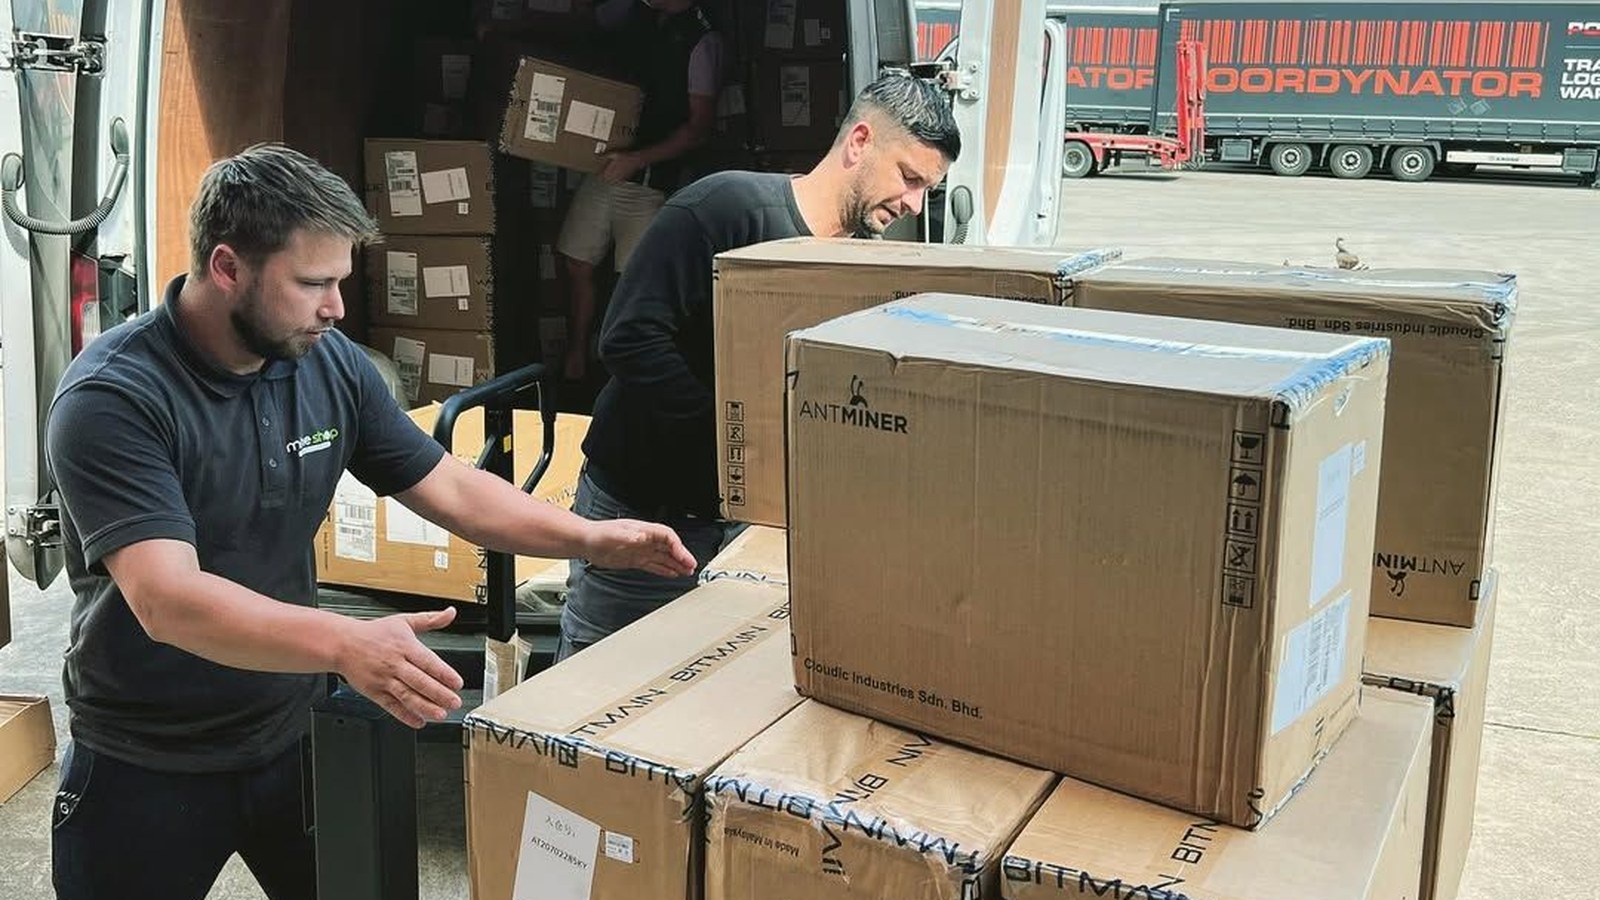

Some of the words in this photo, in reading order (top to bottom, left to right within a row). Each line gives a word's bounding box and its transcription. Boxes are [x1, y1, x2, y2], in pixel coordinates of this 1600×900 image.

[1205, 67, 1542, 98] OORDYNATOR
[1285, 317, 1316, 330] Bhd.
[1355, 320, 1425, 336] Industries
[1428, 324, 1484, 339] Cloudic
[799, 400, 908, 434] ANTMINER
[1372, 552, 1466, 576] ANTMIN
[669, 625, 768, 682] BITMAIN
[803, 656, 850, 681] Cloudic
[852, 671, 915, 700] Industries
[917, 689, 948, 710] Sdn.
[951, 699, 984, 720] Bhd.
[774, 840, 800, 858] Made
